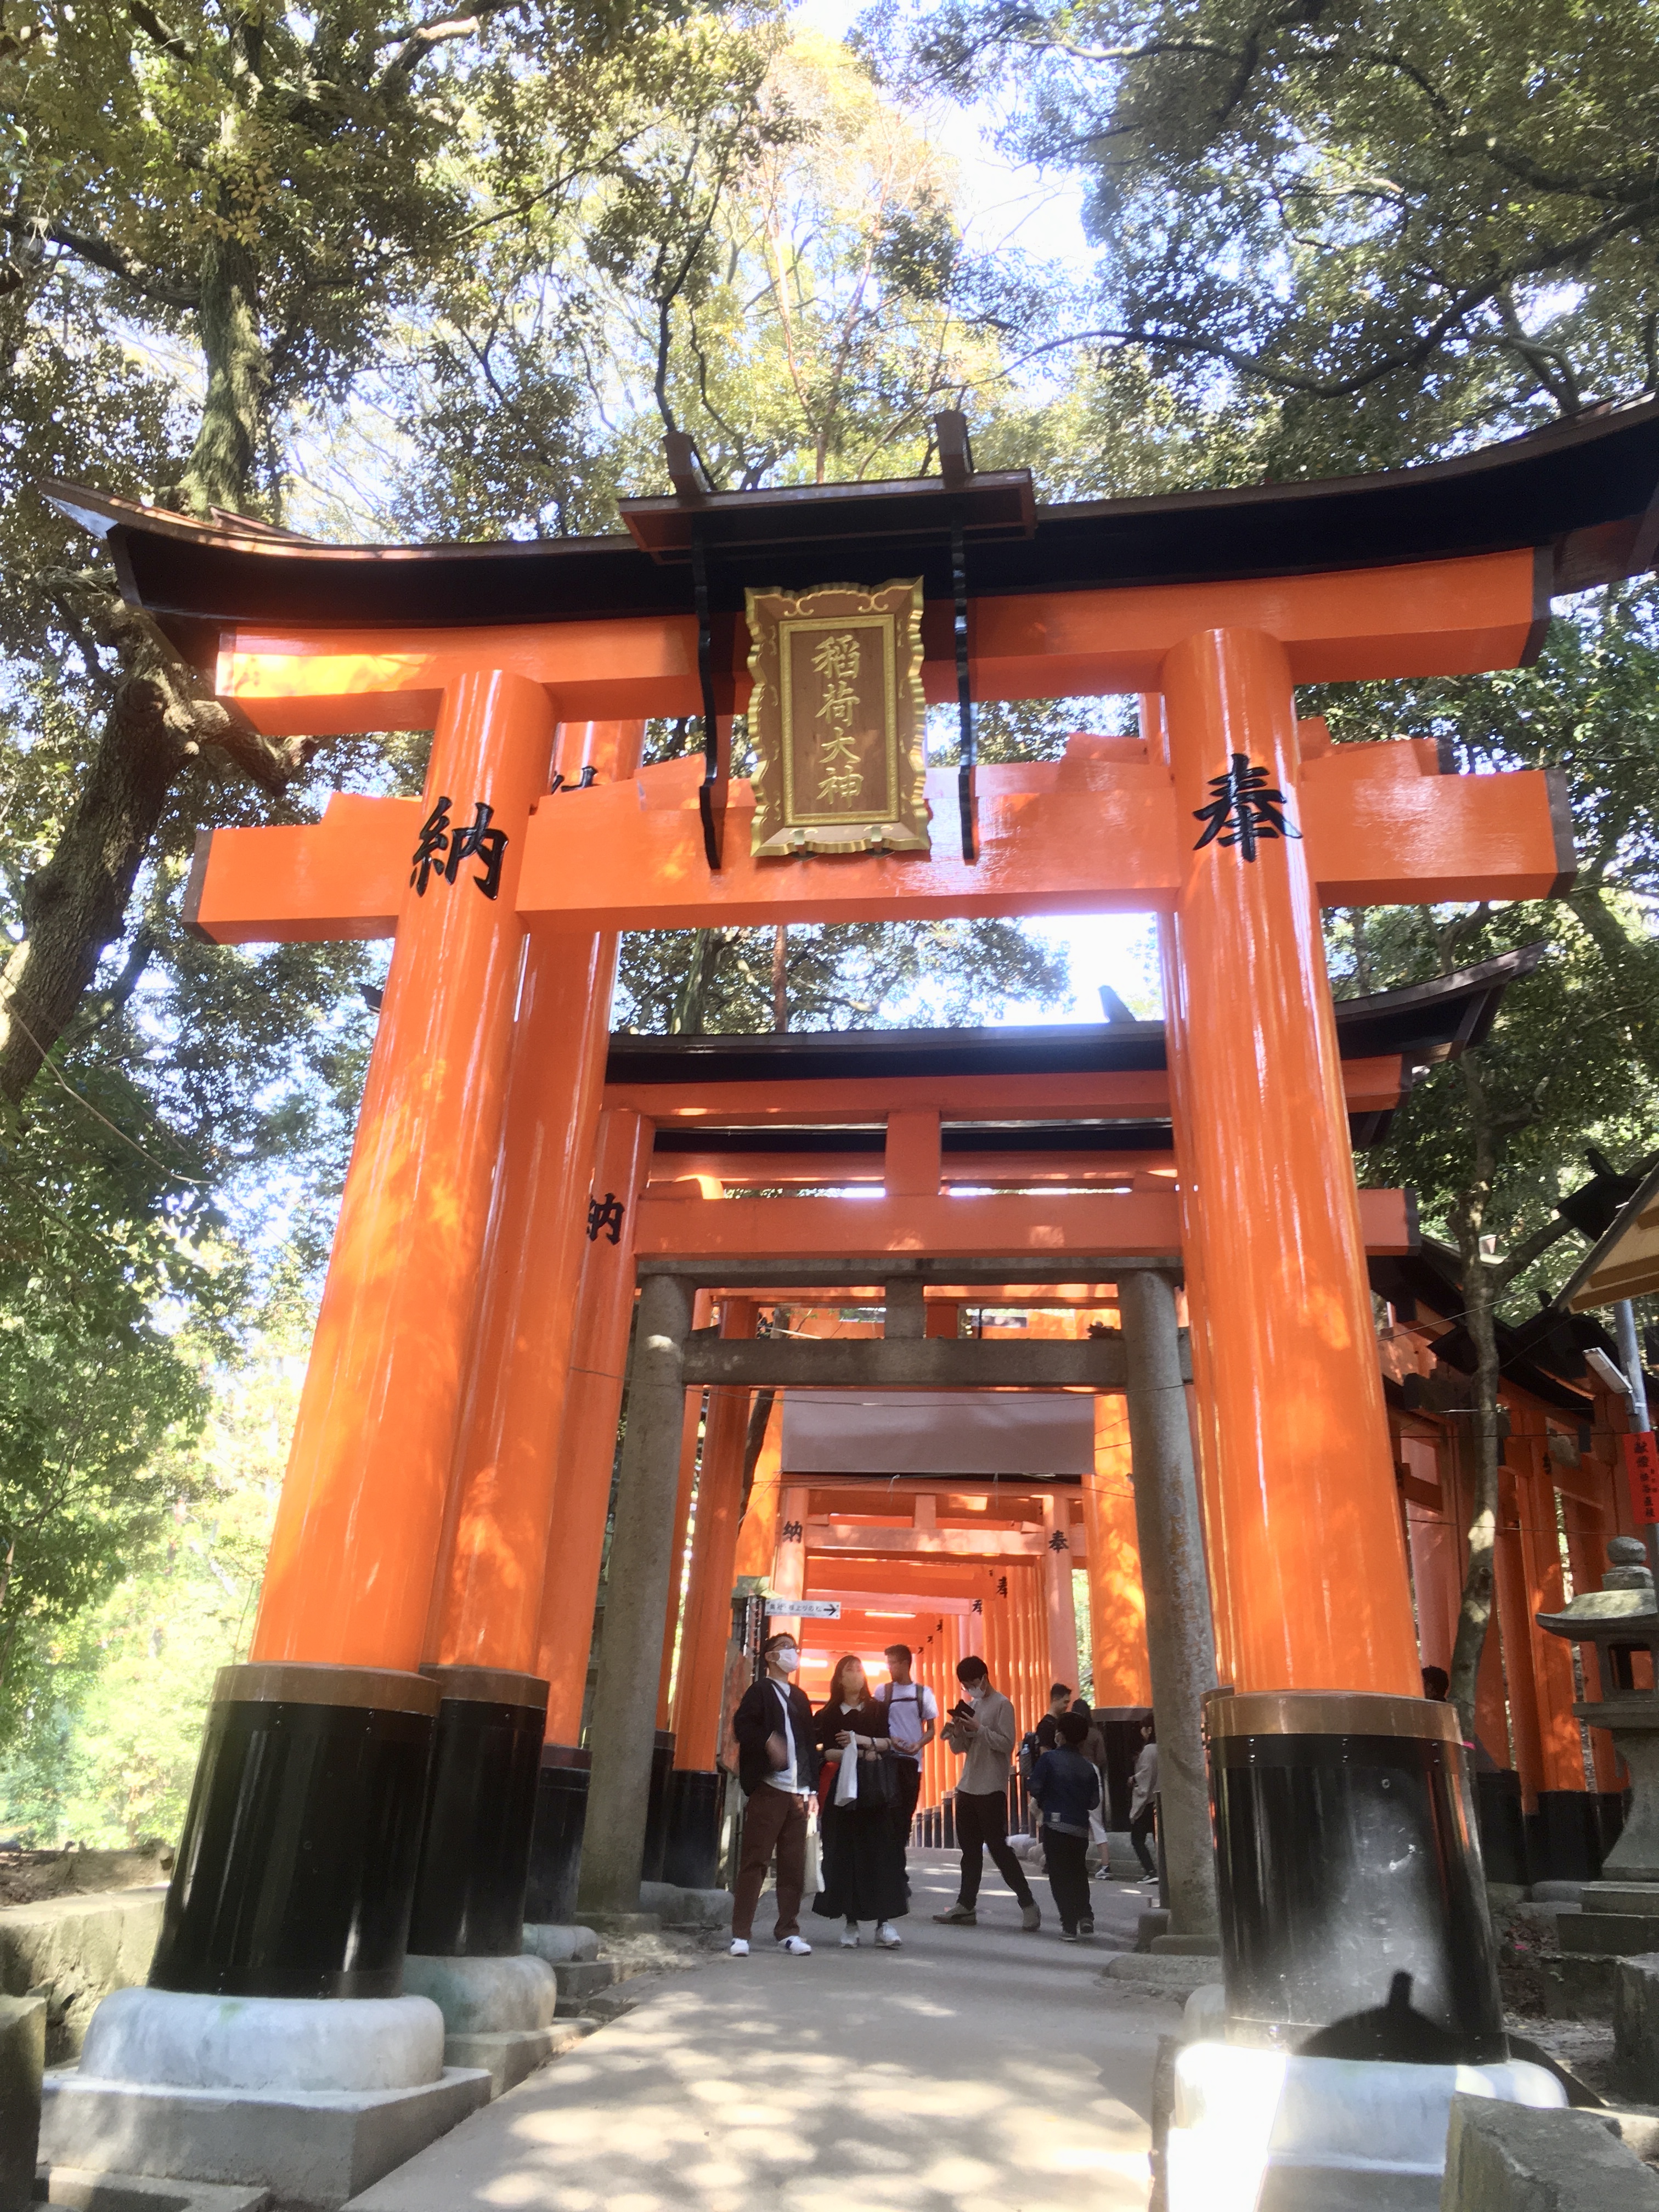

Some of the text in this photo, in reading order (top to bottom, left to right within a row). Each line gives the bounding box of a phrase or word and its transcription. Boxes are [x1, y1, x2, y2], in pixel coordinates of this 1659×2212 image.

[1192, 753, 1303, 862] 奉
[409, 796, 509, 900] 納
[782, 1520, 803, 1544] 納
[1048, 1530, 1069, 1554] 奉
